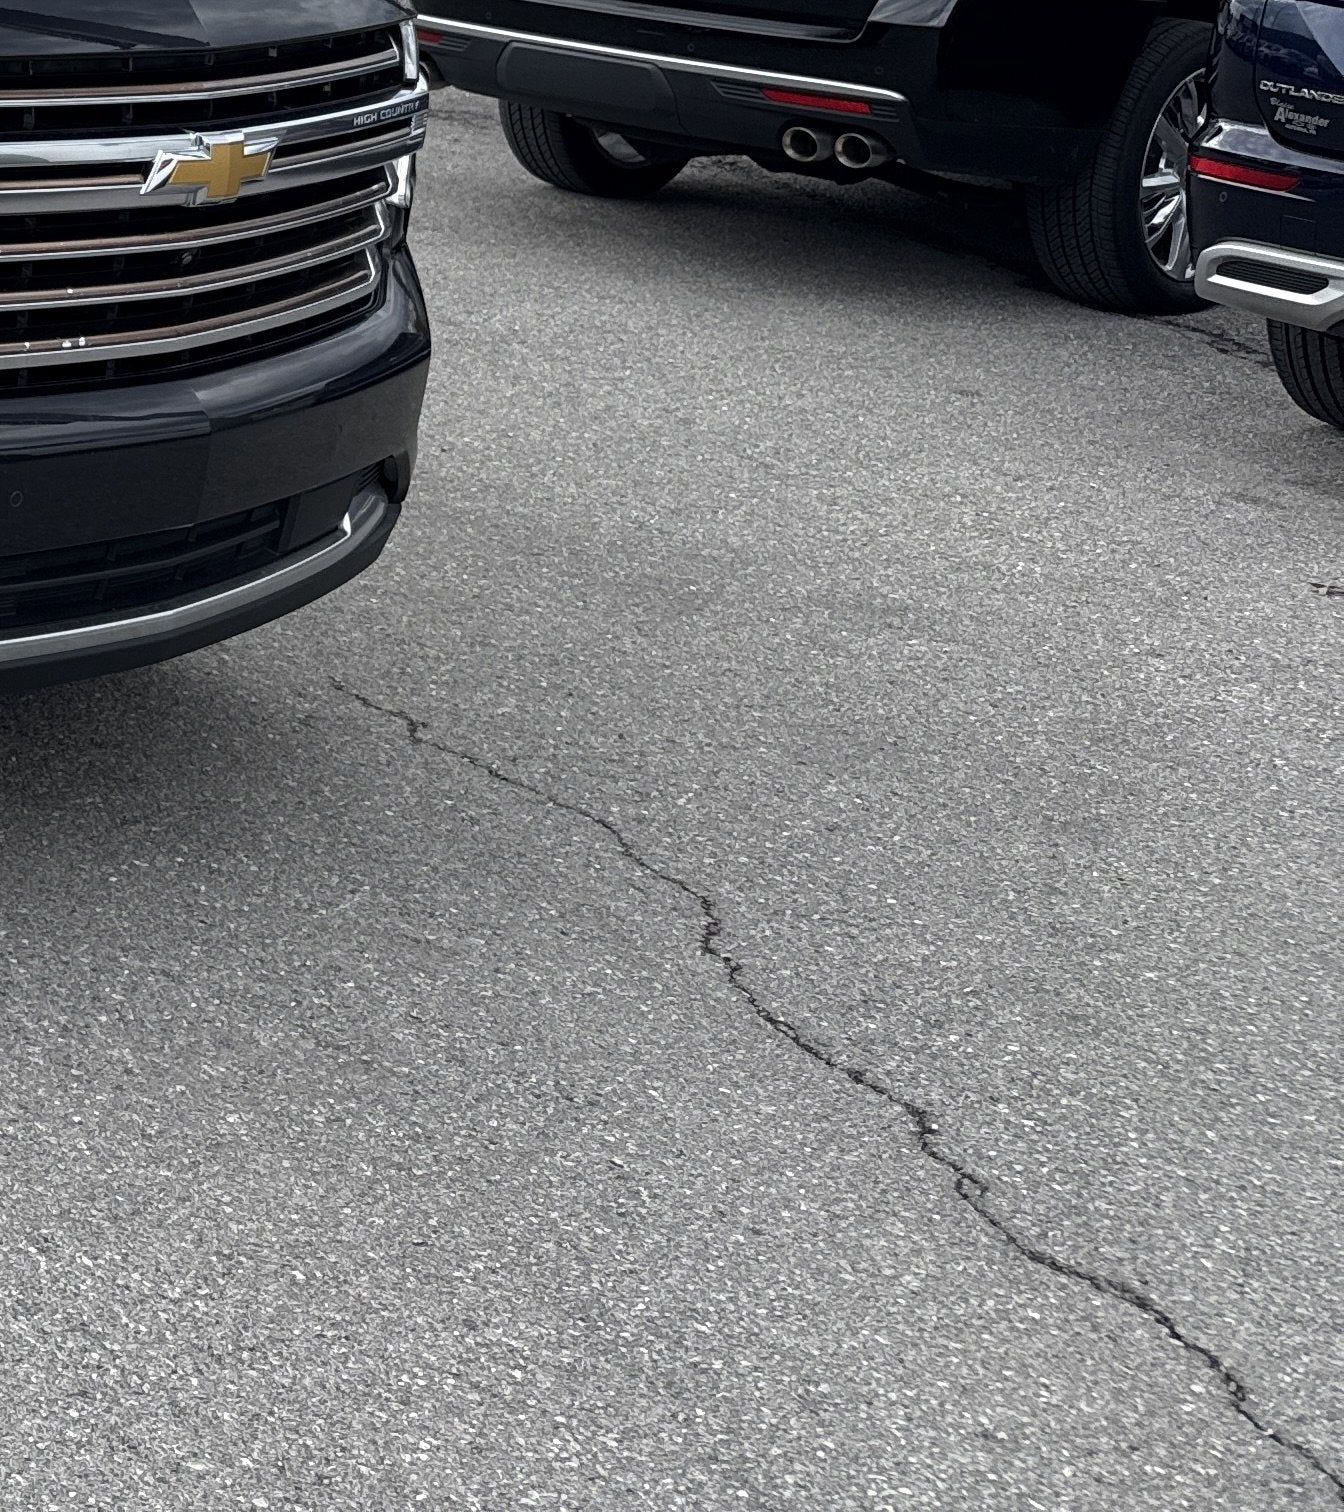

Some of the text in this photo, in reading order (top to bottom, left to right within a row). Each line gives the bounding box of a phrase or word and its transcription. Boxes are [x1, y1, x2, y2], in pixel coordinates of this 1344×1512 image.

[1259, 80, 1344, 105] OUTLANDE
[353, 101, 420, 126] HIGH COUNTRY
[1274, 106, 1330, 128] Alexander
